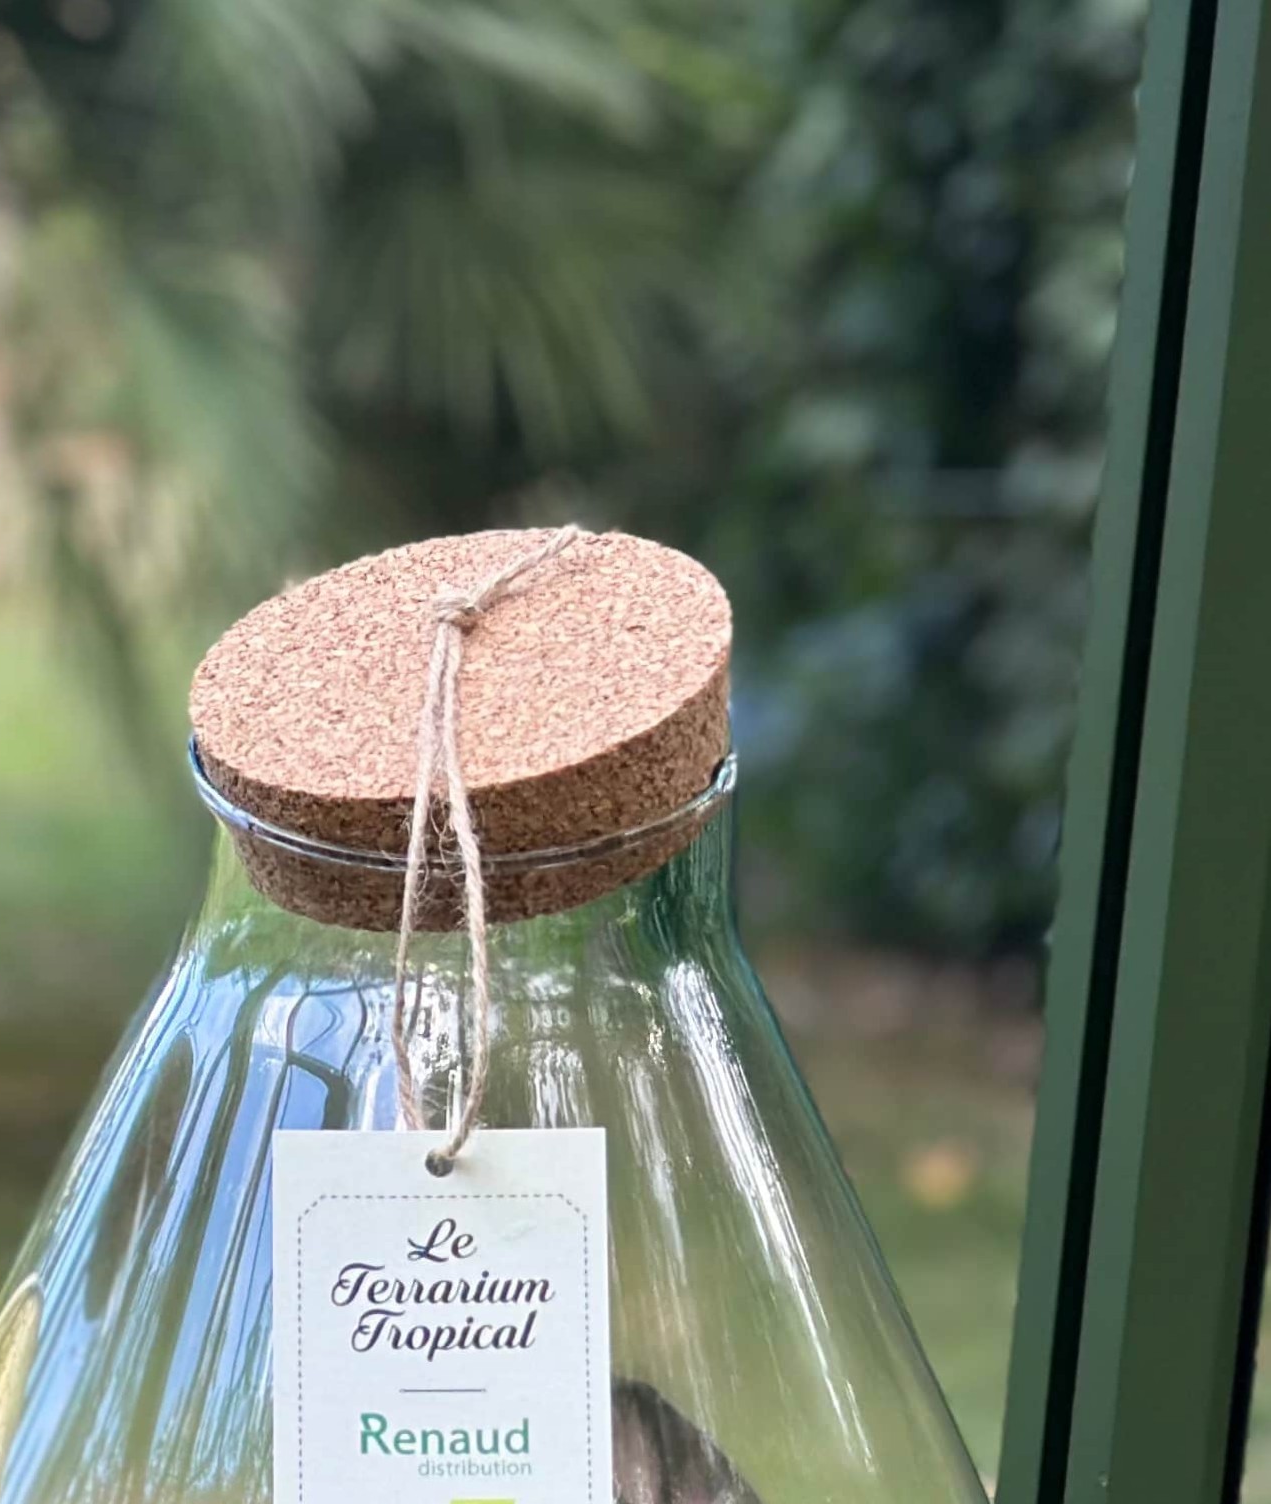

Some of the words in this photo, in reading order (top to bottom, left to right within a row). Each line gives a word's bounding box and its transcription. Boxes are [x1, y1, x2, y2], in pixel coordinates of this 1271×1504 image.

[406, 1218, 477, 1263] Le
[330, 1262, 555, 1307] Terrarium
[351, 1308, 538, 1363] Tropical
[360, 1412, 530, 1456] Renaud
[417, 1459, 533, 1477] distribution
